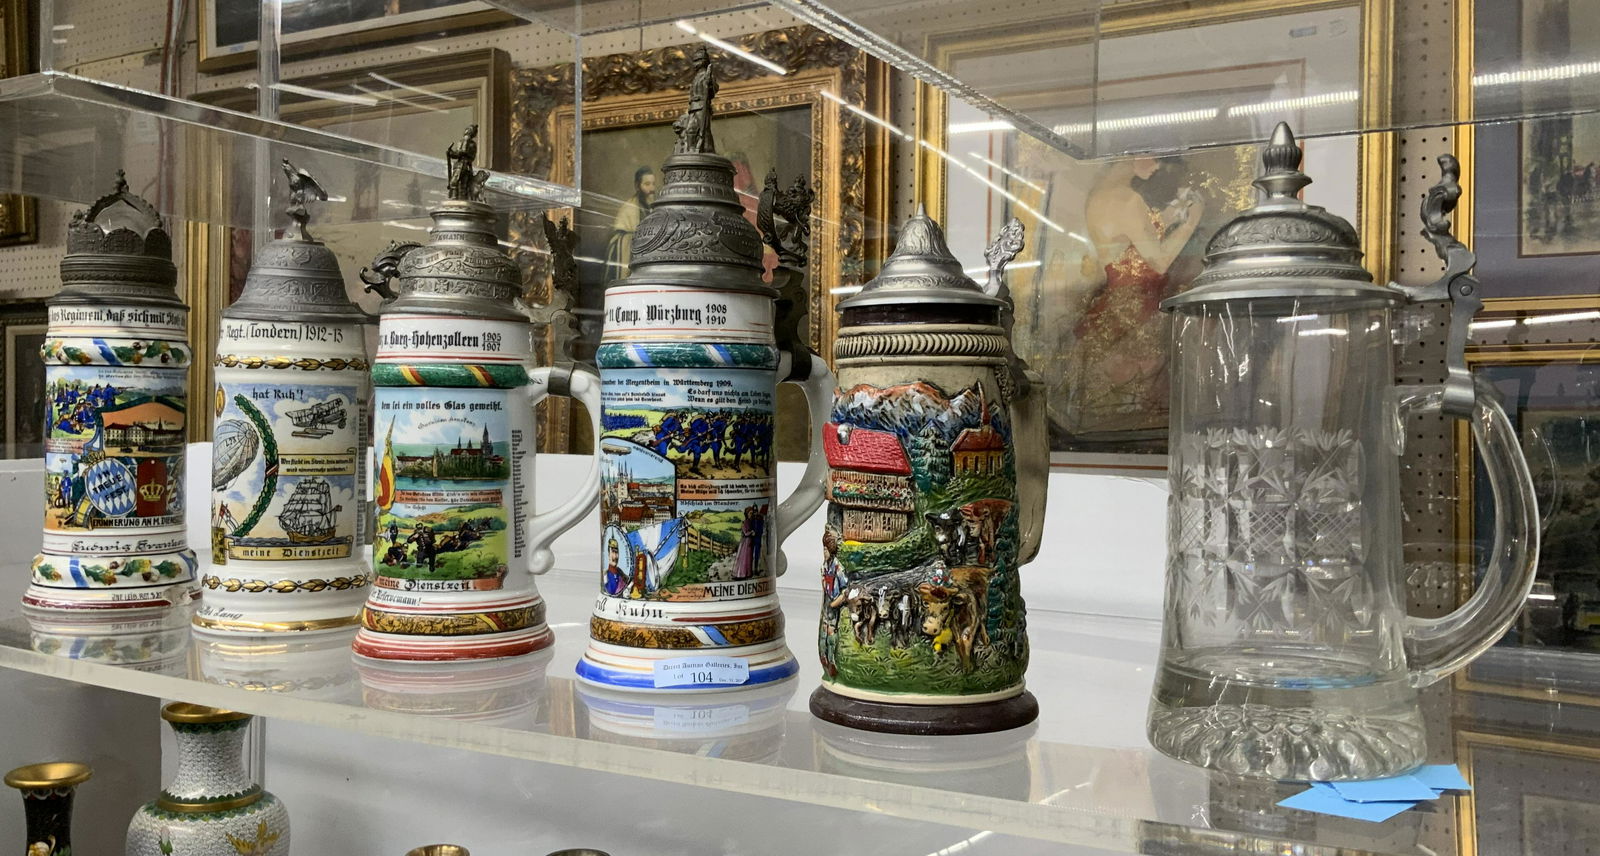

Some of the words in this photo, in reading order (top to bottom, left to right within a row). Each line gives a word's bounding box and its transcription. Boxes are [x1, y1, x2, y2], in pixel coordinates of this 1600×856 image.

[615, 306, 641, 325] Comp.
[646, 304, 702, 325] Würzburg
[706, 304, 727, 314] 1908
[706, 315, 727, 325] 1910
[306, 324, 343, 344] 1912-13
[482, 332, 502, 342] 1905
[482, 342, 501, 352] 1907
[673, 378, 713, 388] Württemberg
[252, 387, 269, 400] hat
[416, 401, 440, 410] volles
[444, 400, 466, 411] Glas
[469, 401, 503, 412] geweiht.
[98, 470, 110, 479] IN
[92, 474, 122, 494] TREUE
[105, 486, 127, 501] FEST
[141, 518, 151, 527] AN
[242, 549, 271, 557] meine
[282, 547, 339, 557] Dienstzeit
[378, 577, 400, 588] meine
[703, 583, 735, 597] MEINE
[690, 671, 713, 683] 104
